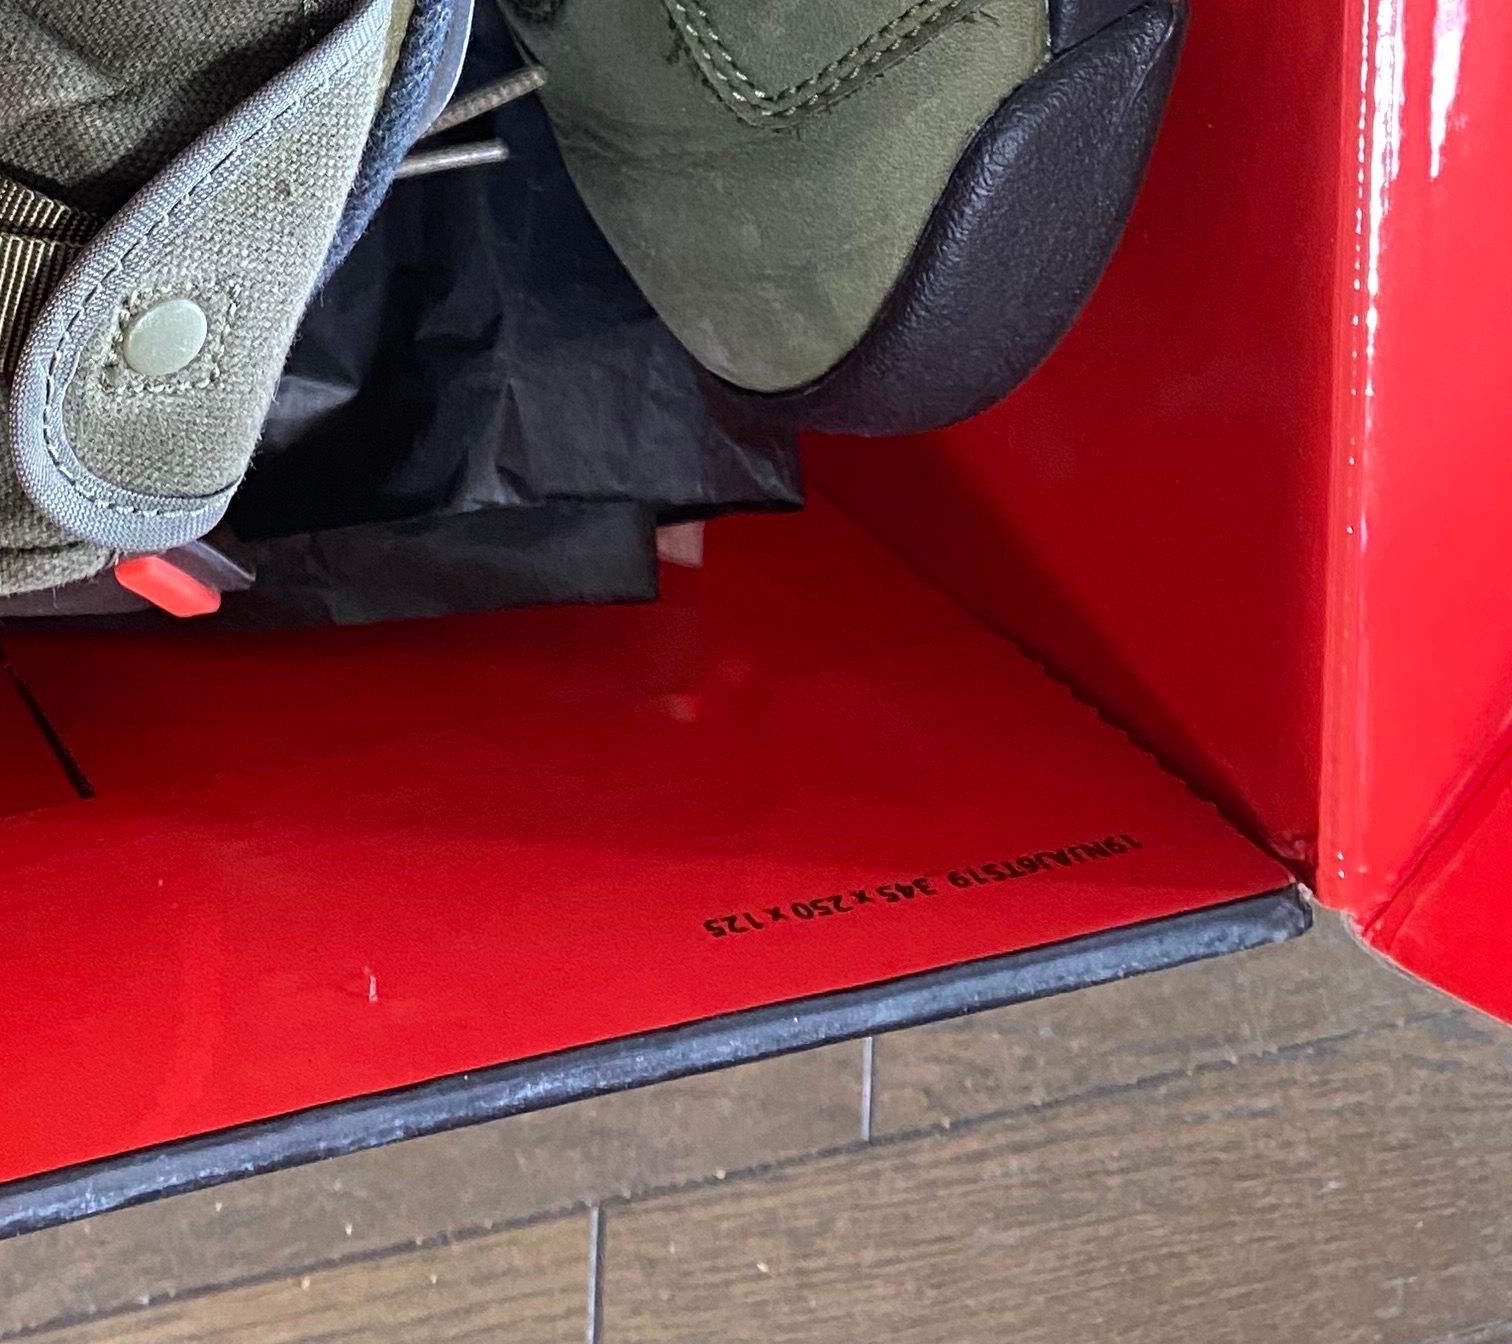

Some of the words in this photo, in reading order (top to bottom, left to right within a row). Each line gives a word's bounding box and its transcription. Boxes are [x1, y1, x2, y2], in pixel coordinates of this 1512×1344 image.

[877, 876, 937, 902] 345
[791, 895, 852, 920] 250
[703, 913, 761, 938] 125
